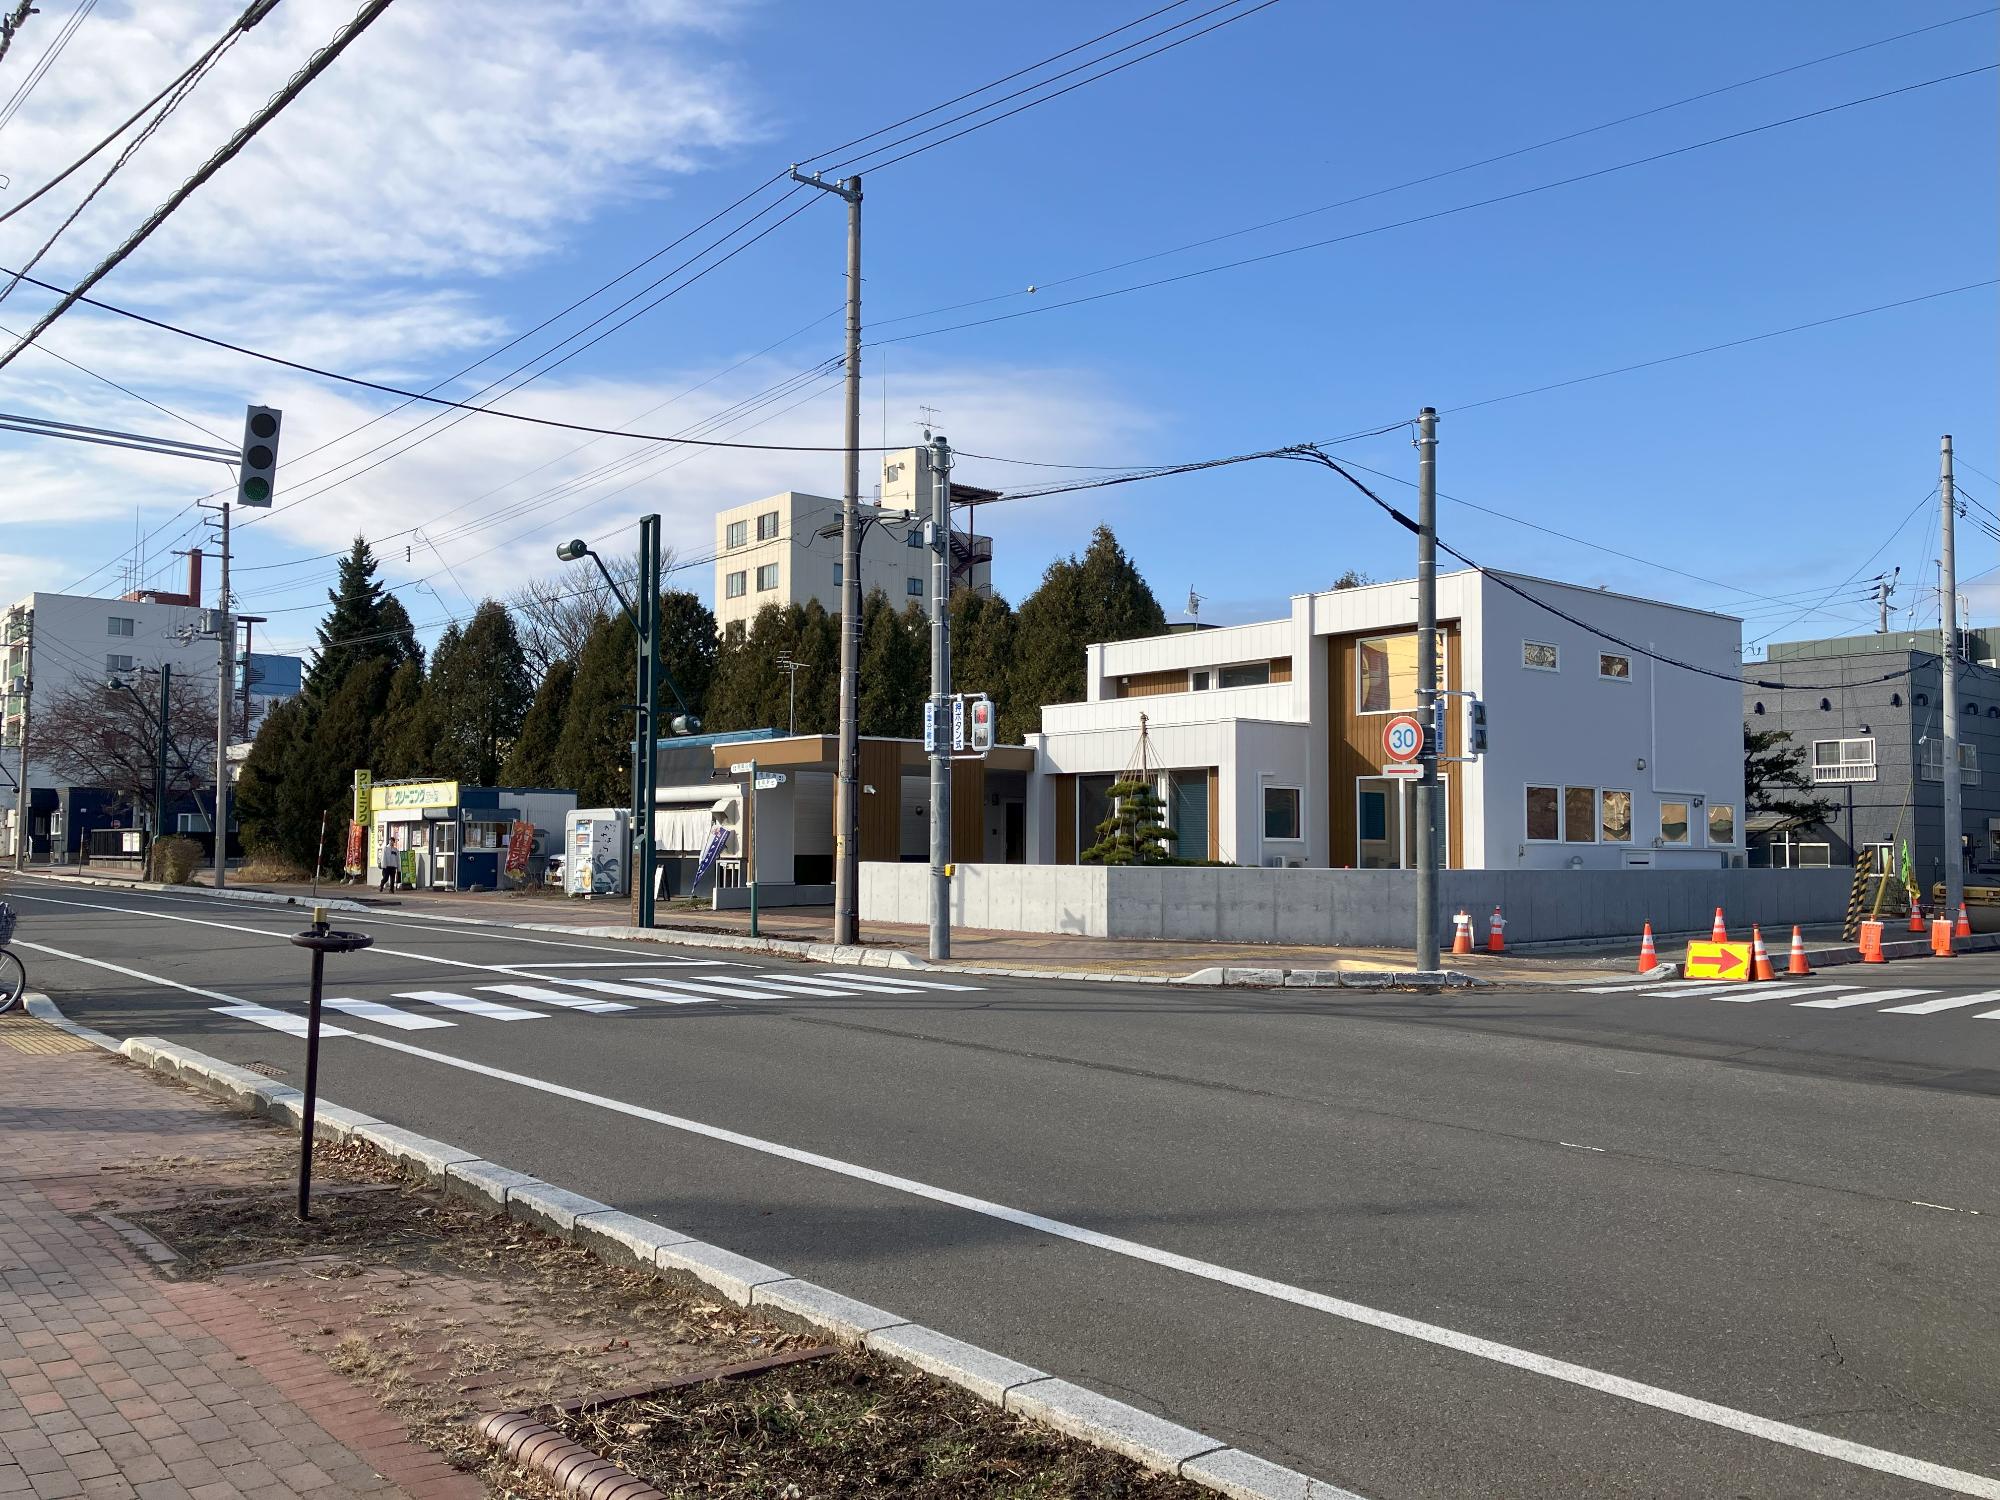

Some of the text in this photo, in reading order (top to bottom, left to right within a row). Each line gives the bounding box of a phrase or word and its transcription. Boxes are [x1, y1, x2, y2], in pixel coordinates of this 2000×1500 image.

[1392, 728, 1414, 749] 30
[395, 789, 425, 806] クリーニング
